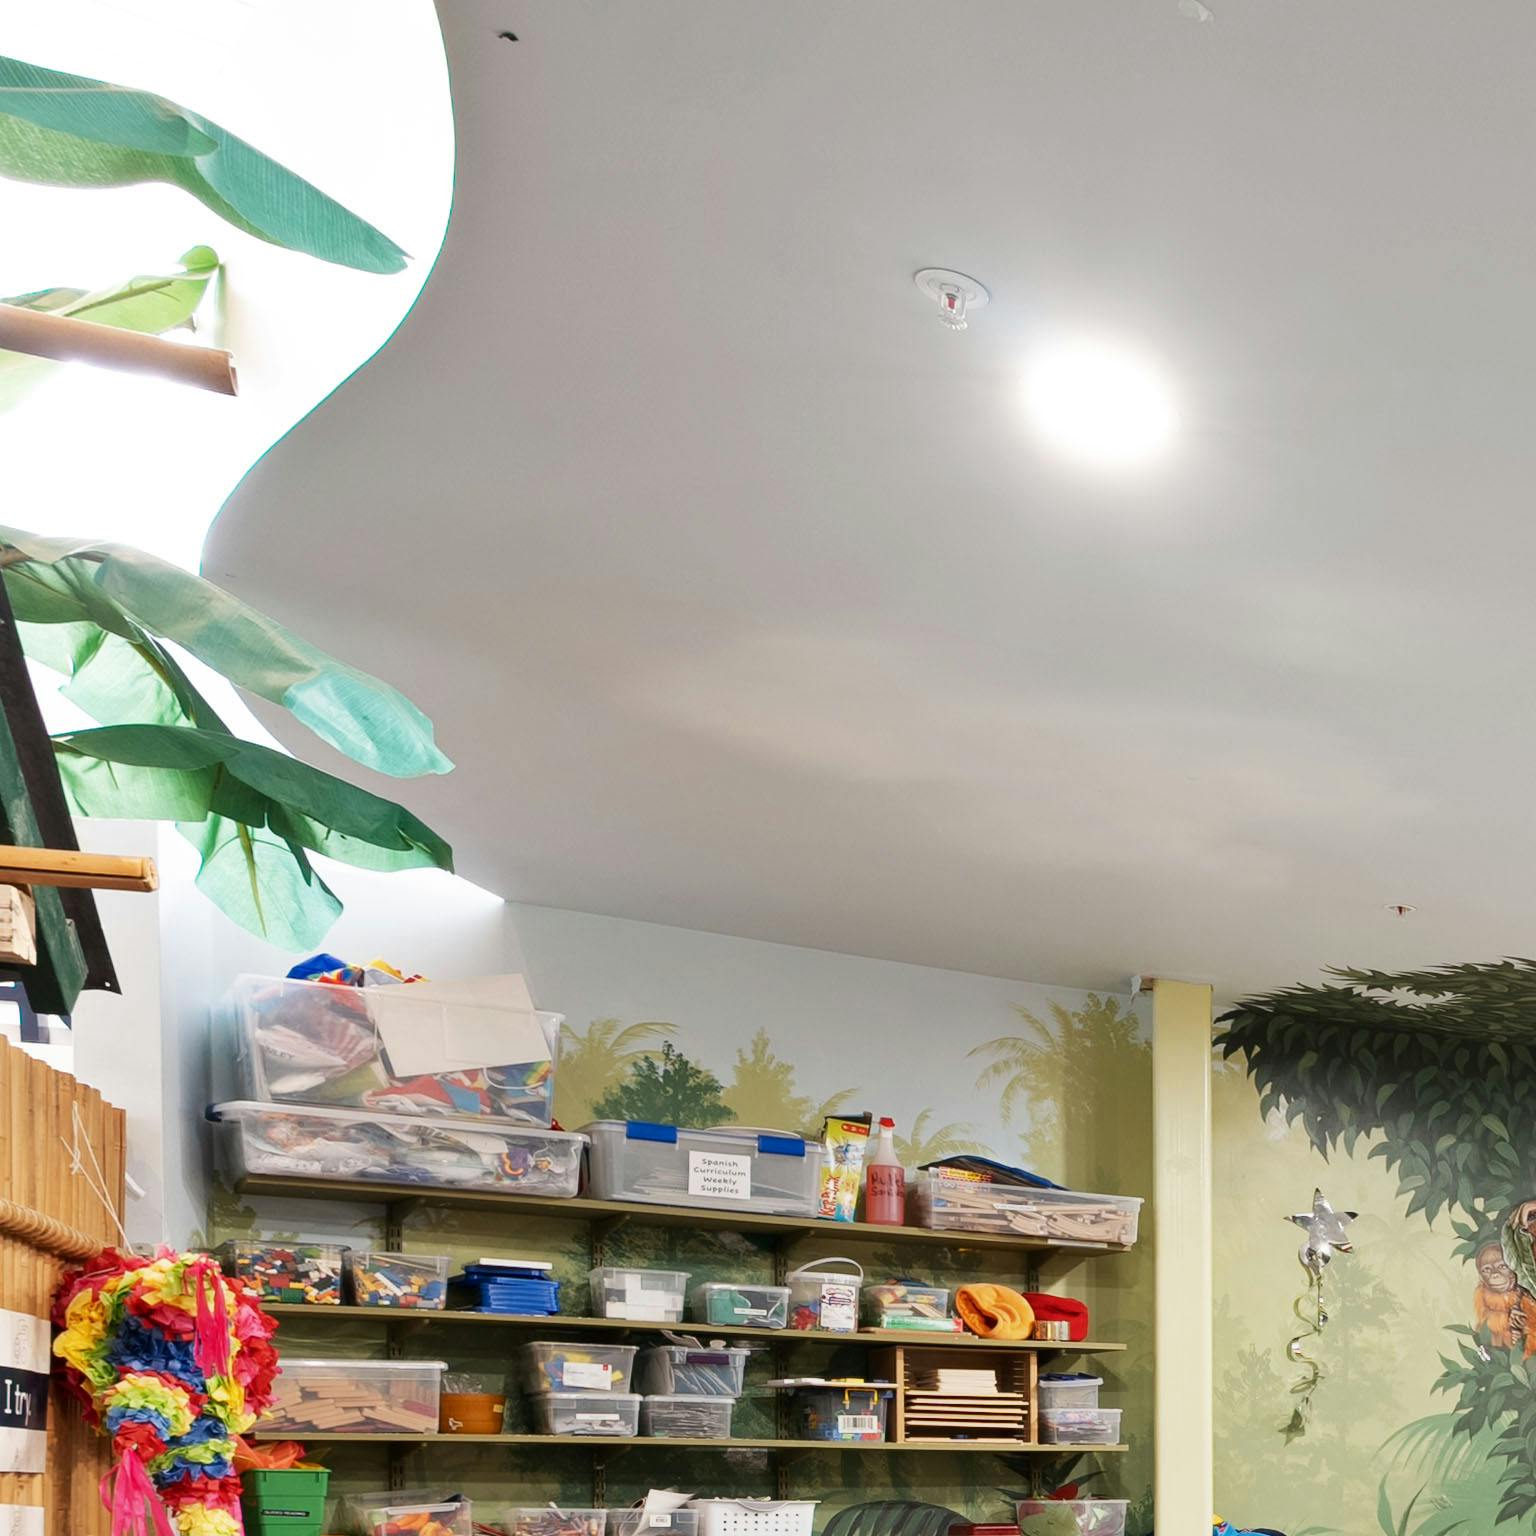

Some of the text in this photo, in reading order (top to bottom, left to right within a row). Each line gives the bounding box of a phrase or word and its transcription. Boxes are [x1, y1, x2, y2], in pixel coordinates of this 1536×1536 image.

[702, 1158, 738, 1167] Spanish
[693, 1166, 746, 1177] Curriculum
[703, 1176, 737, 1185] Weekly
[700, 1184, 739, 1193] Supplies
[4, 1379, 31, 1426] I try.
